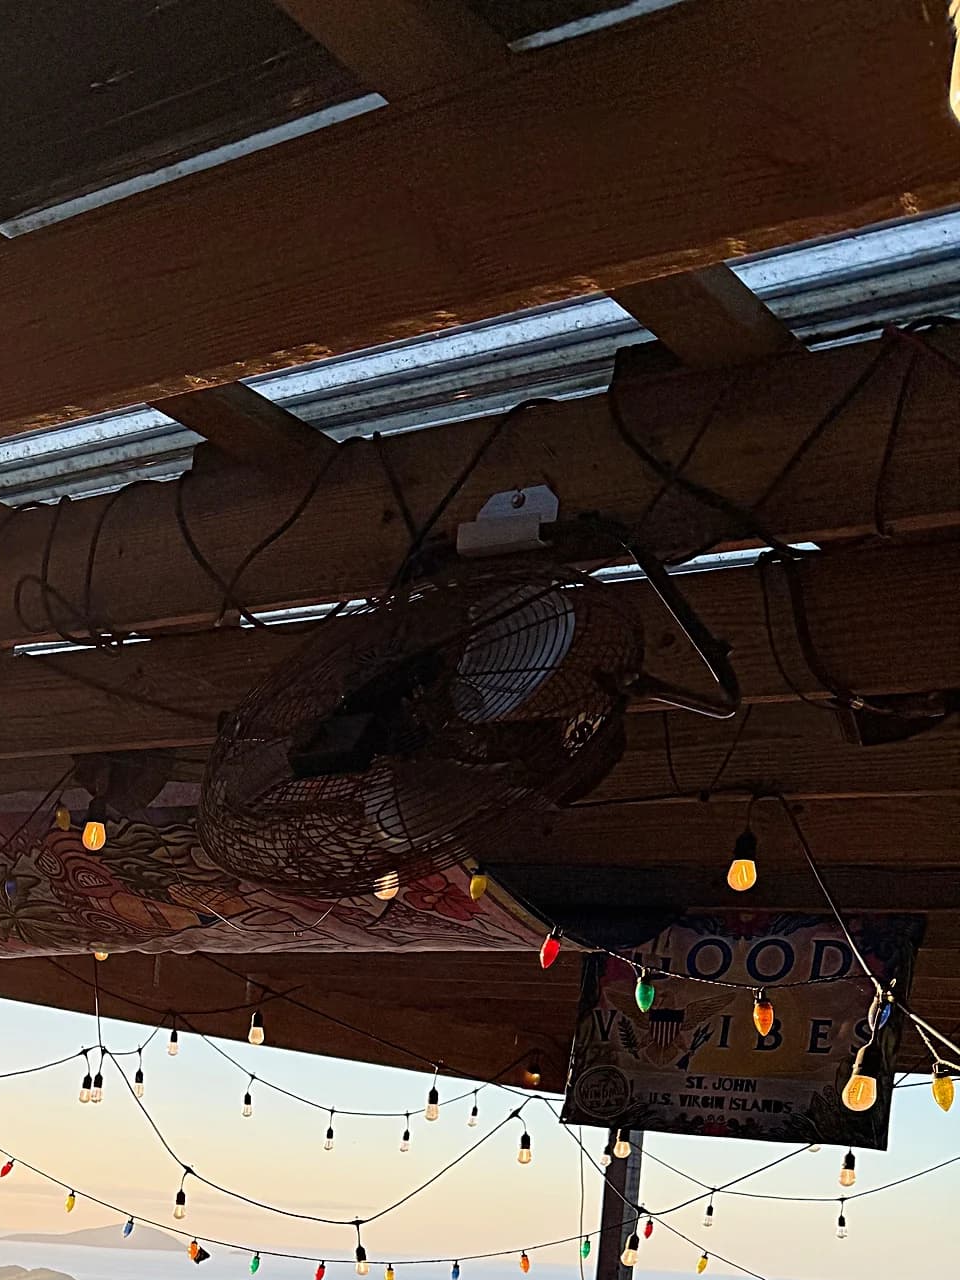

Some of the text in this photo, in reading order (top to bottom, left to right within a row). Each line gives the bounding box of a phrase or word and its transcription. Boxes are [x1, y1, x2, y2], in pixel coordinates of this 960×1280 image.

[685, 1077, 757, 1093] ST. JOHN
[649, 1093, 793, 1114] U.S. VIRGIN ISLANDS
